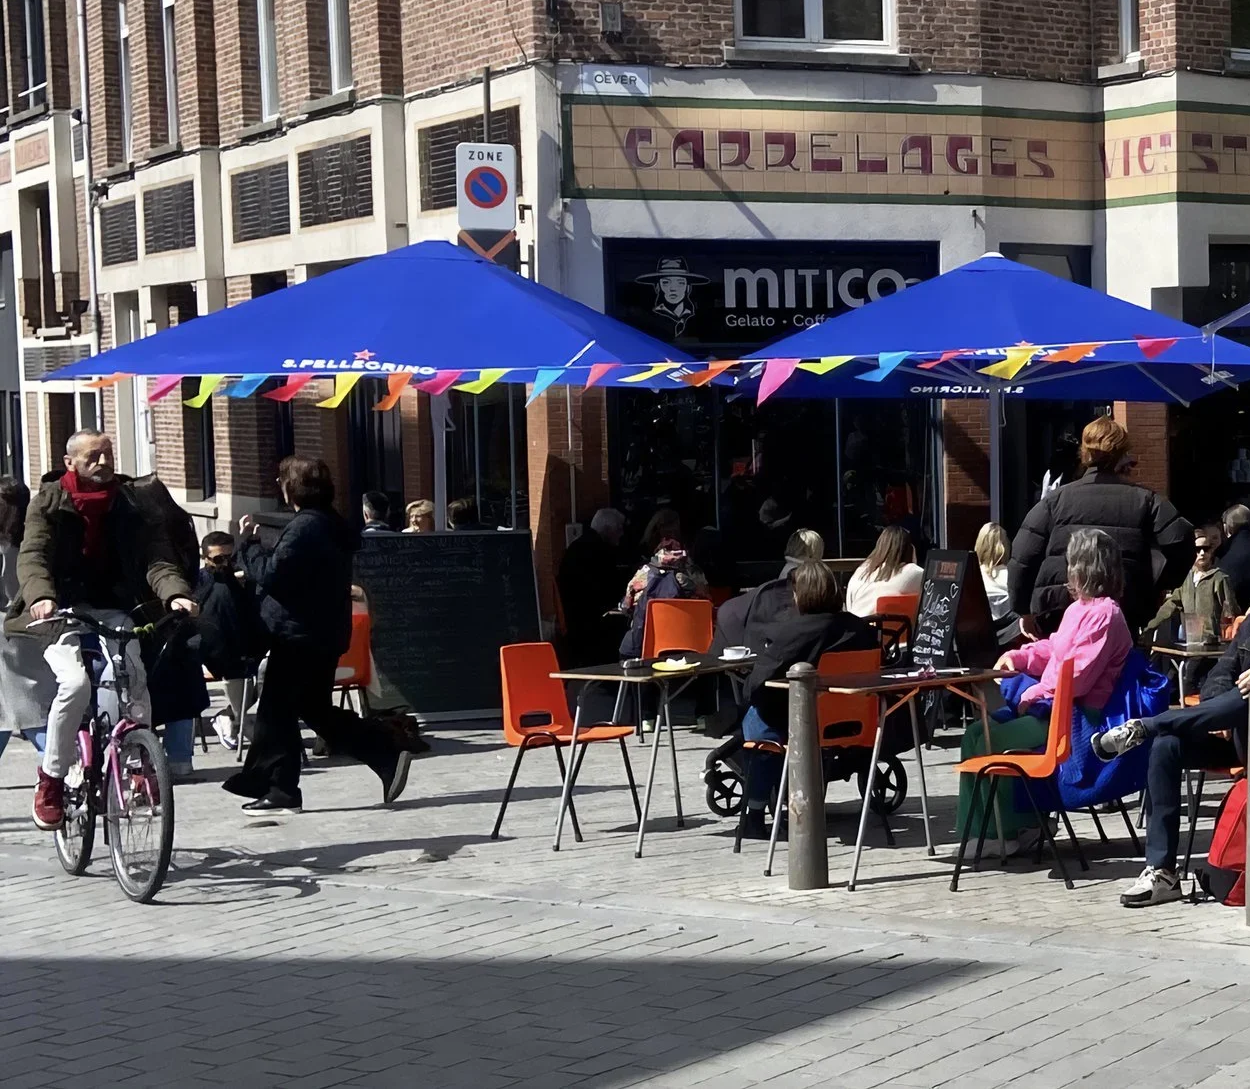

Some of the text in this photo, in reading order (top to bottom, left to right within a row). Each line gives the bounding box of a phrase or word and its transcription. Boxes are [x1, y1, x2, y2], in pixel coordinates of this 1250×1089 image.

[593, 73, 638, 85] OEVER
[468, 150, 503, 162] ZONE
[624, 127, 1056, 178] CARRELAGES
[725, 314, 776, 327] Gelato
[282, 358, 437, 375] S.PELLEGRINO
